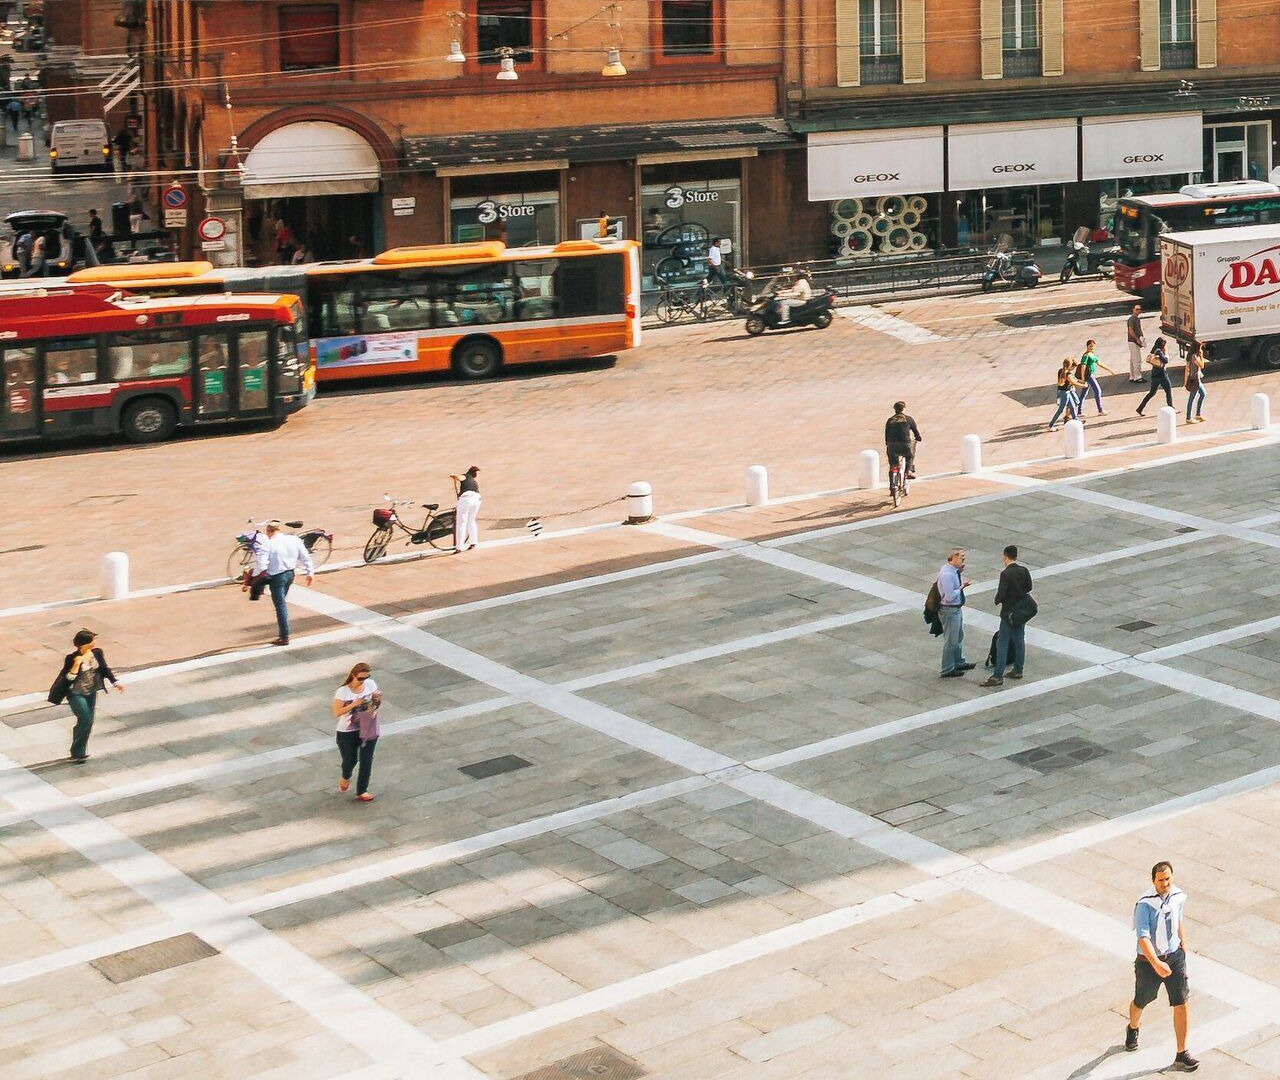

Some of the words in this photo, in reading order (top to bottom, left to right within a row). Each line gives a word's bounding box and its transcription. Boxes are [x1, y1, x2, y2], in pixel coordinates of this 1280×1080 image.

[1123, 154, 1164, 164] GEOX
[992, 163, 1036, 174] GEOX
[853, 172, 900, 184] GEOX
[666, 187, 684, 209] 3
[686, 190, 719, 203] Store
[478, 201, 497, 224] 3
[499, 205, 535, 218] Store
[1217, 255, 1240, 264] Gruppo
[1220, 306, 1254, 315] eccellenza
[1256, 305, 1267, 313] per
